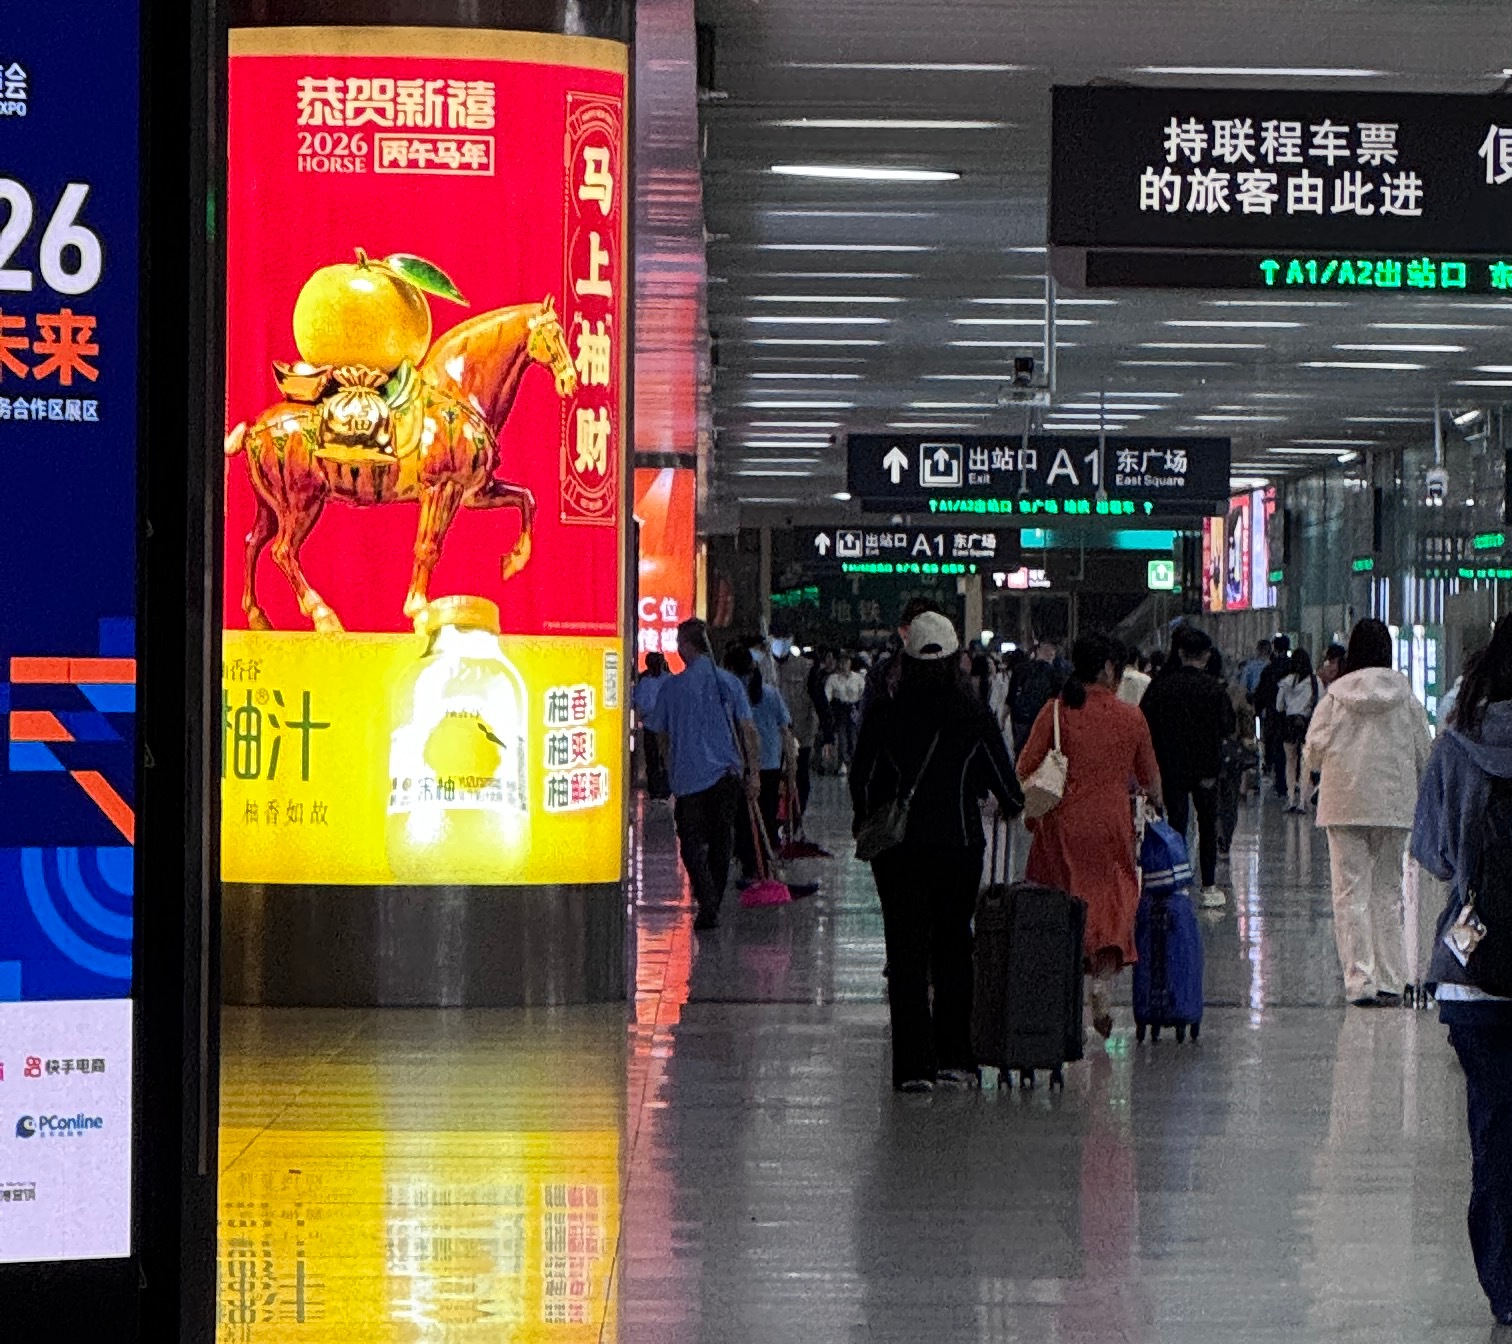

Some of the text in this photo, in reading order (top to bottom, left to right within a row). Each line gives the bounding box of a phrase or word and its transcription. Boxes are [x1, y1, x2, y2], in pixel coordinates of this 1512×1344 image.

[297, 76, 496, 130] 恭贺新禧
[297, 131, 369, 156] 2026
[1163, 116, 1400, 166] 持联程车票
[297, 156, 367, 174] HORSE
[380, 139, 489, 170] 丙午马年
[1139, 166, 1424, 217] 的旅客由此进
[1286, 258, 1466, 289] A1/A2出站口
[968, 446, 1038, 472] 出站口
[1046, 447, 1099, 486] A1
[1115, 447, 1188, 474] 东广场
[968, 473, 992, 485] Exit
[1115, 474, 1185, 488] East Square
[865, 532, 907, 549] 出站口
[911, 532, 945, 556] A1
[953, 533, 996, 549] 东广场
[222, 658, 262, 682] 香谷
[45, 1058, 106, 1076] 快手电商
[38, 1112, 104, 1131] PConline
